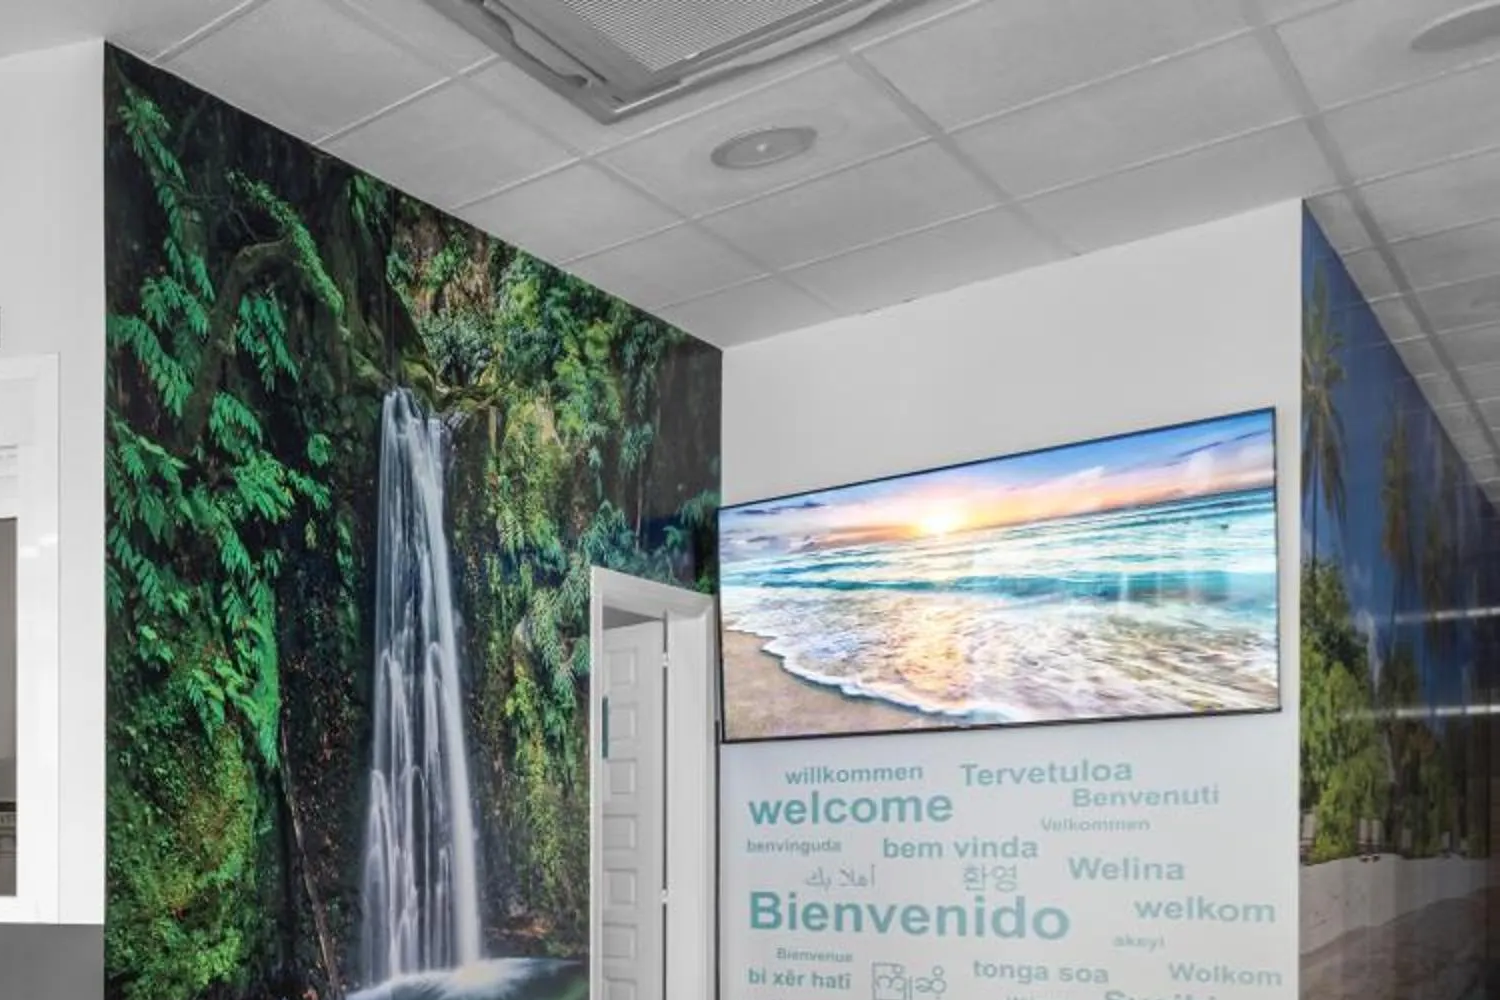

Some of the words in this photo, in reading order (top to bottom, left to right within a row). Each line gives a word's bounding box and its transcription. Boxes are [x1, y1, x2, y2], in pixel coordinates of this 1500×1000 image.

[785, 765, 924, 785] willkommen
[960, 760, 1133, 787] Tervetuloa
[749, 790, 953, 825] welcome
[1072, 783, 1220, 808] Benvenuti
[746, 838, 842, 856] benvinguda
[883, 838, 943, 859] bem
[953, 836, 1039, 859] vinda
[963, 864, 1018, 892] 환영
[1068, 857, 1186, 882] Welina
[749, 891, 1071, 941] Bienvenido
[1133, 896, 1277, 924] welkom
[776, 947, 854, 963] Bienvenue
[748, 968, 767, 985] bi
[973, 960, 1049, 985] tonga
[1059, 966, 1110, 985] soa
[1168, 962, 1283, 986] Wolkom
